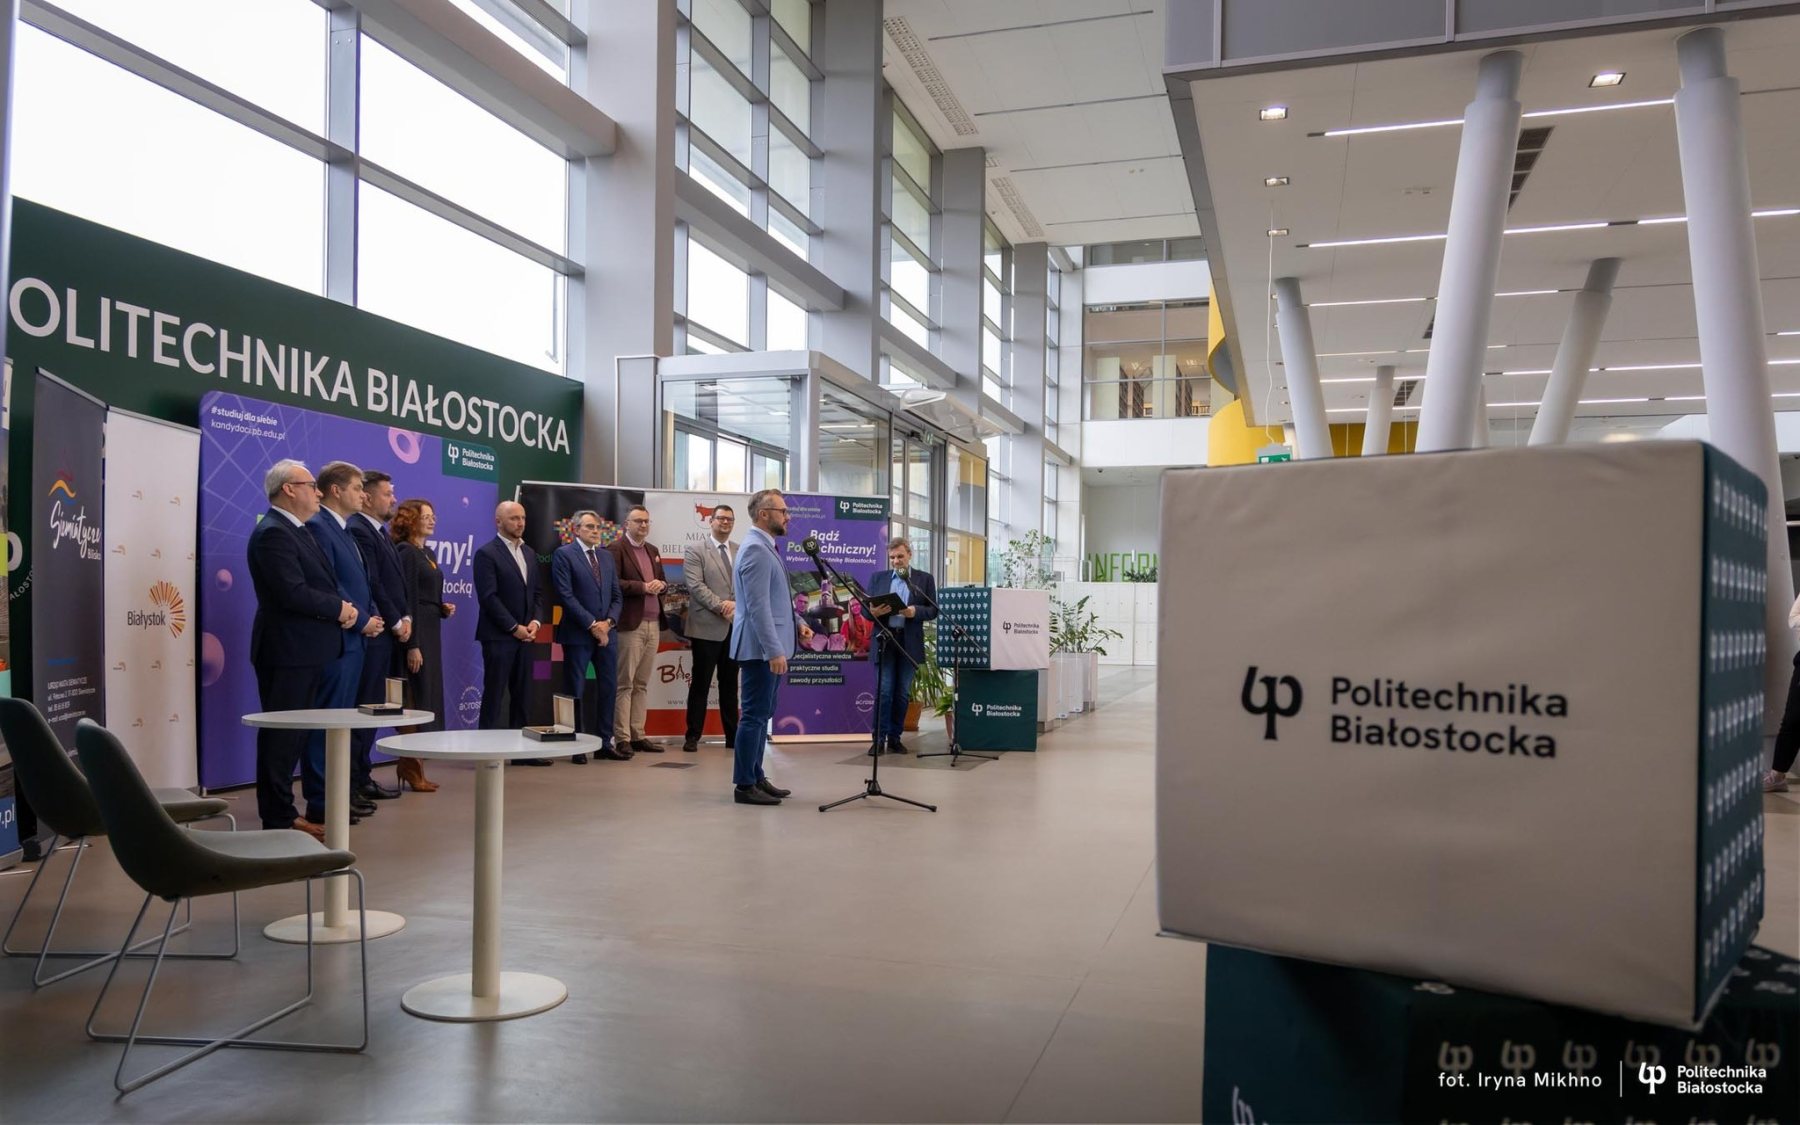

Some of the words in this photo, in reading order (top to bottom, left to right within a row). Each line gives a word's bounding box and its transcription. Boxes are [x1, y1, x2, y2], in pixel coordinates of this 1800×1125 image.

[244, 412, 256, 422] dla
[256, 415, 277, 426] siebie
[367, 367, 570, 455] BIAŁOSTOCKA
[462, 448, 495, 462] Politechnika
[462, 458, 494, 471] Białostocka
[810, 529, 840, 544] Bądź
[127, 609, 166, 630] Białystok
[1331, 676, 1568, 717] Politechnika
[1330, 714, 1557, 758] Białostocka
